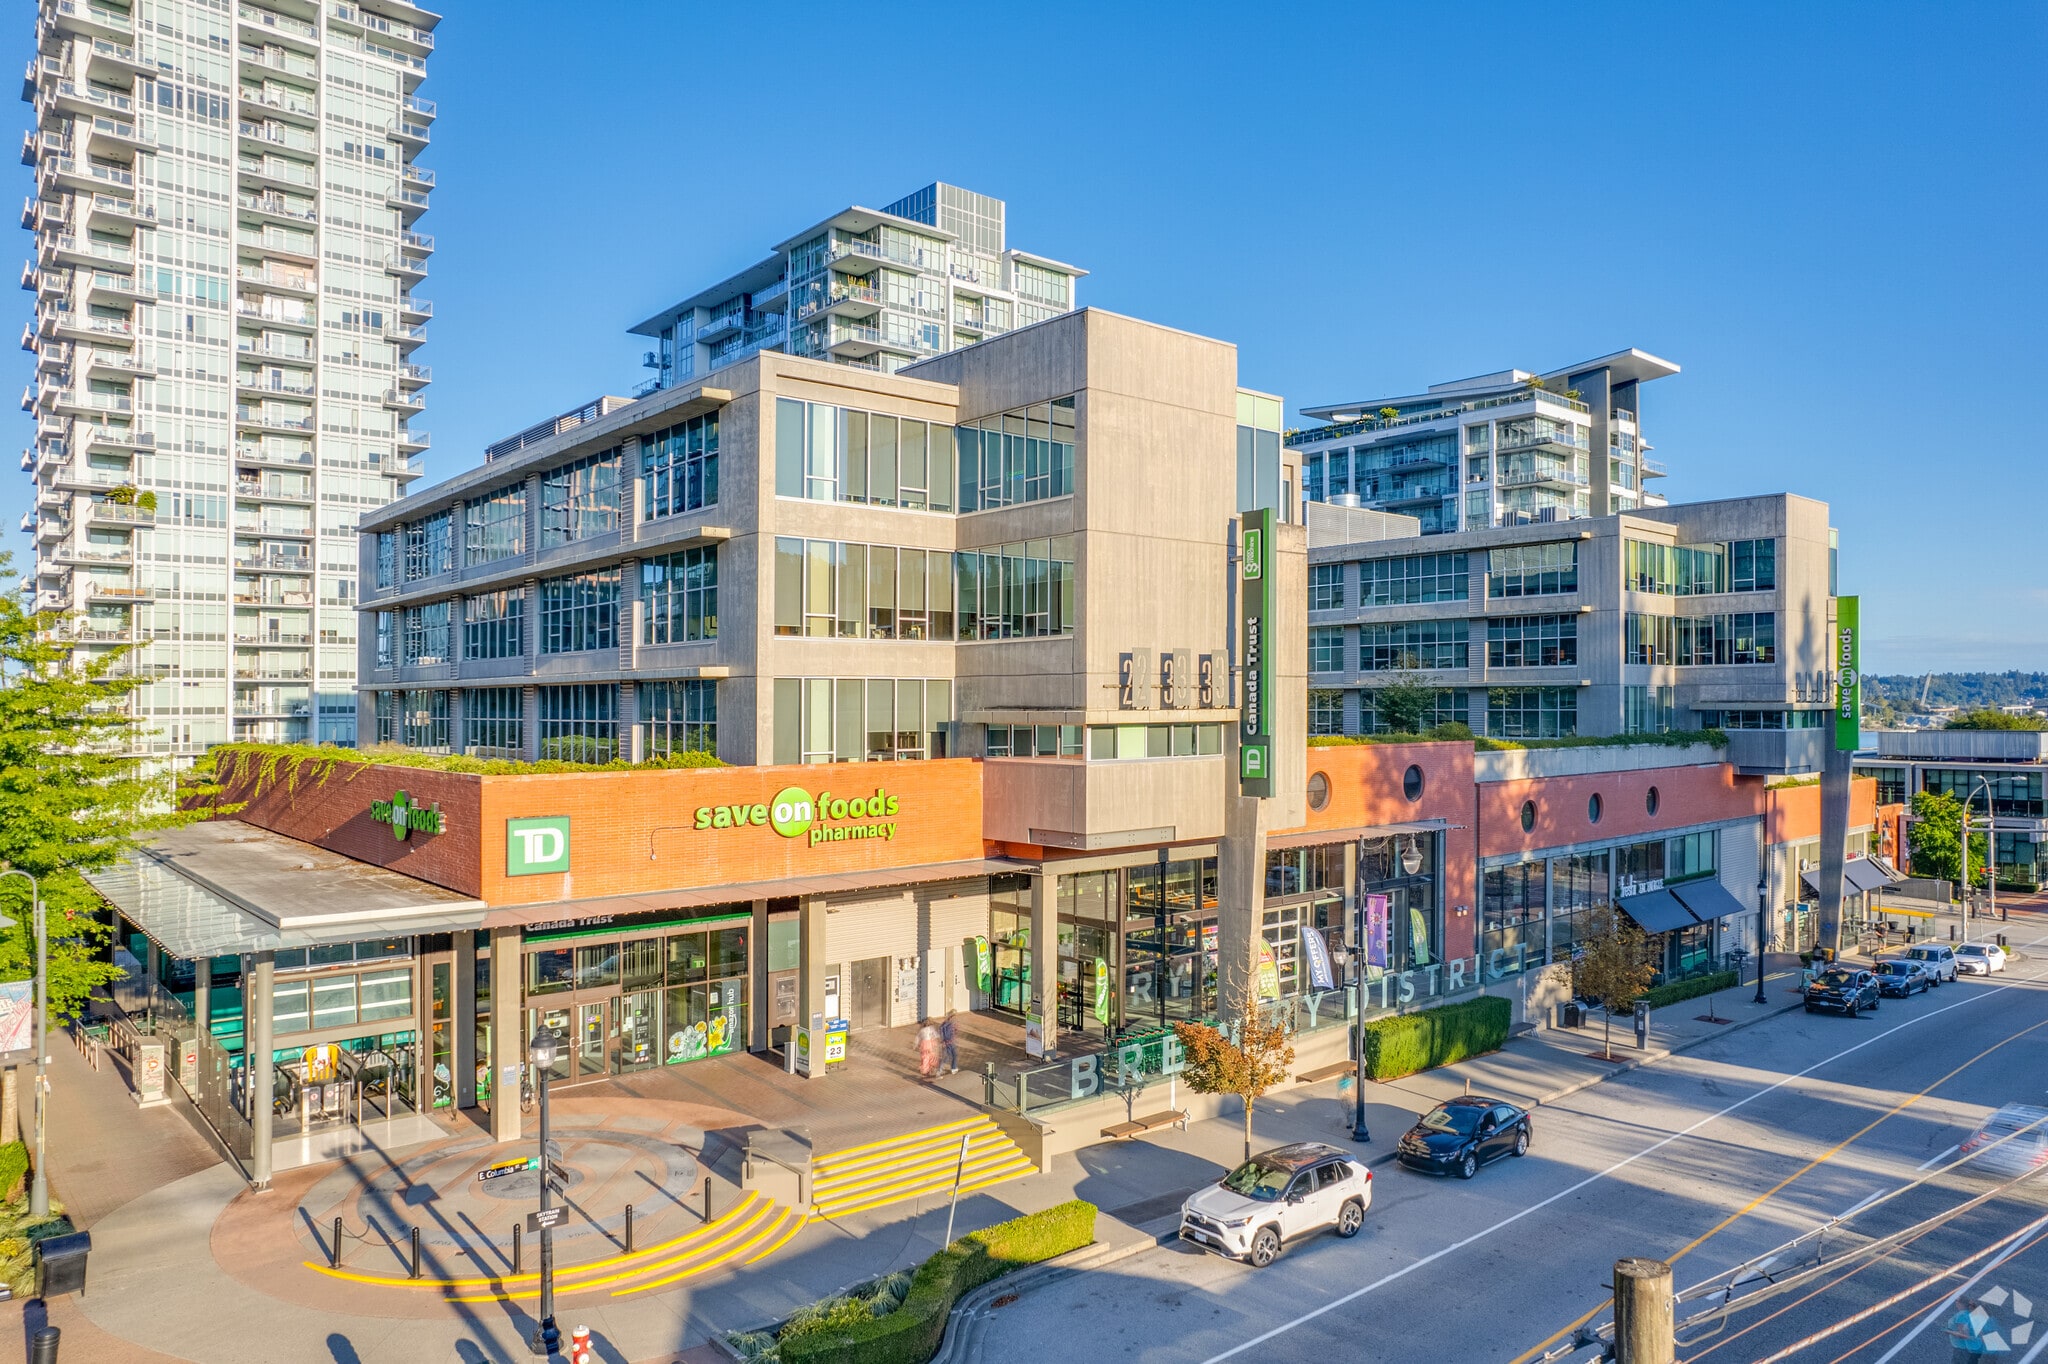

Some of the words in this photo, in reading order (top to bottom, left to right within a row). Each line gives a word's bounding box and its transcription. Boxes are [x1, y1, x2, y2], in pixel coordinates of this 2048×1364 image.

[1246, 617, 1258, 668] Trust
[1839, 628, 1852, 667] foods
[1841, 667, 1852, 686] on
[1246, 670, 1258, 736] Canada
[1841, 688, 1852, 719] save
[1247, 749, 1260, 775] TD
[371, 799, 392, 825] save
[393, 805, 406, 826] on
[407, 798, 440, 835] foods
[695, 803, 768, 830] save
[774, 800, 812, 824] on
[818, 788, 900, 821] foods
[513, 827, 565, 865] TD
[810, 821, 898, 848] pharmacy
[526, 918, 576, 932] Canada
[577, 914, 614, 927] Trust
[1307, 930, 1321, 967] OFFERS
[1315, 968, 1325, 983] MY
[1347, 943, 1527, 1018] DISTRICT
[727, 988, 735, 1005] hub
[728, 1005, 736, 1034] amazon
[479, 1172, 484, 1180] E
[486, 1166, 514, 1179] Columbia
[536, 1208, 560, 1218] SKYTRAIN
[538, 1214, 558, 1222] STATION
